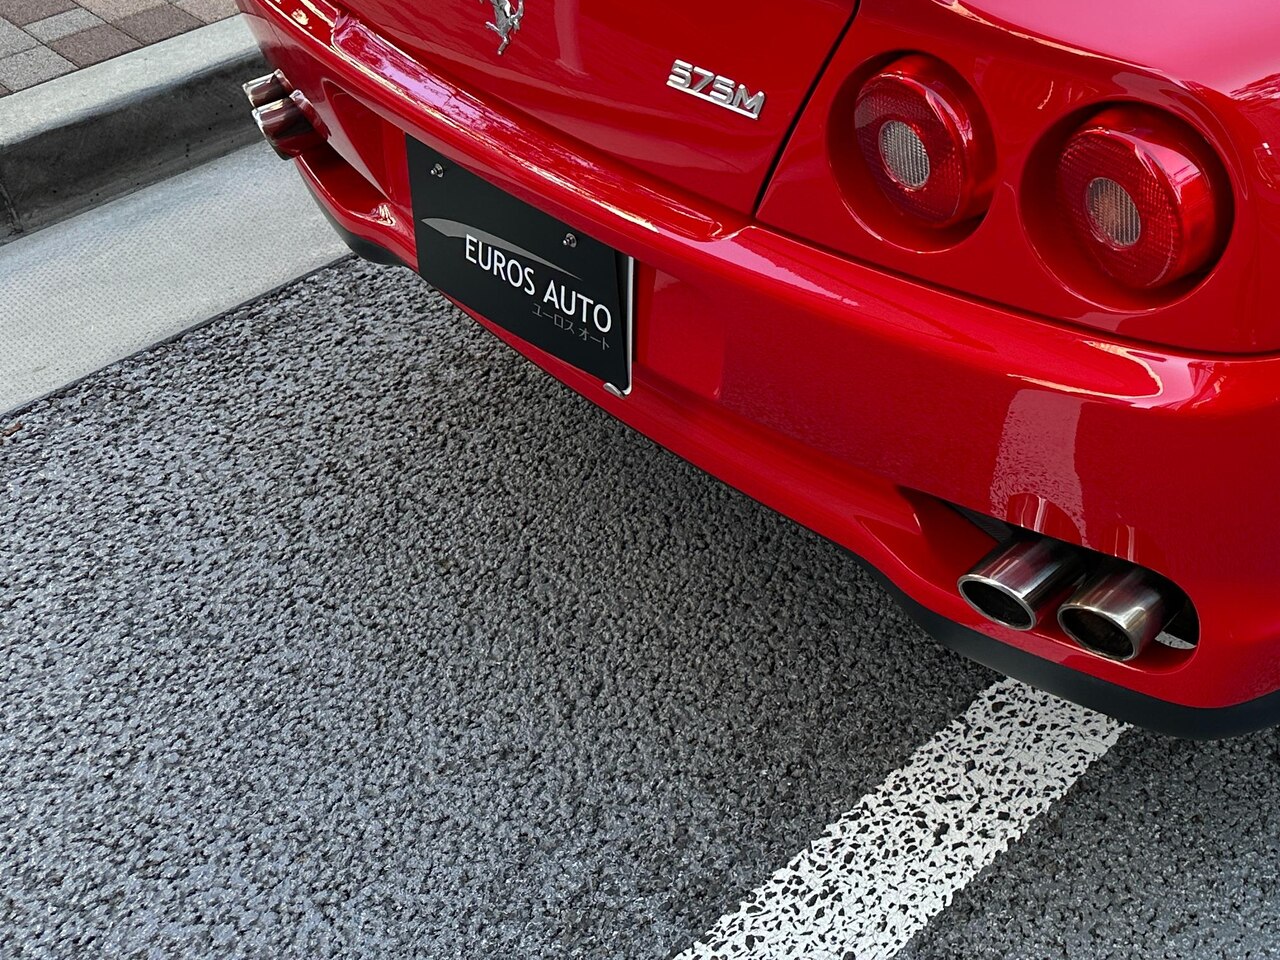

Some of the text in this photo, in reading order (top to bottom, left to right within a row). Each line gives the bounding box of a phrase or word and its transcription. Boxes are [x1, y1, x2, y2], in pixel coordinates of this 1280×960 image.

[666, 59, 765, 120] 575M
[465, 233, 612, 333] EUROS AUTO
